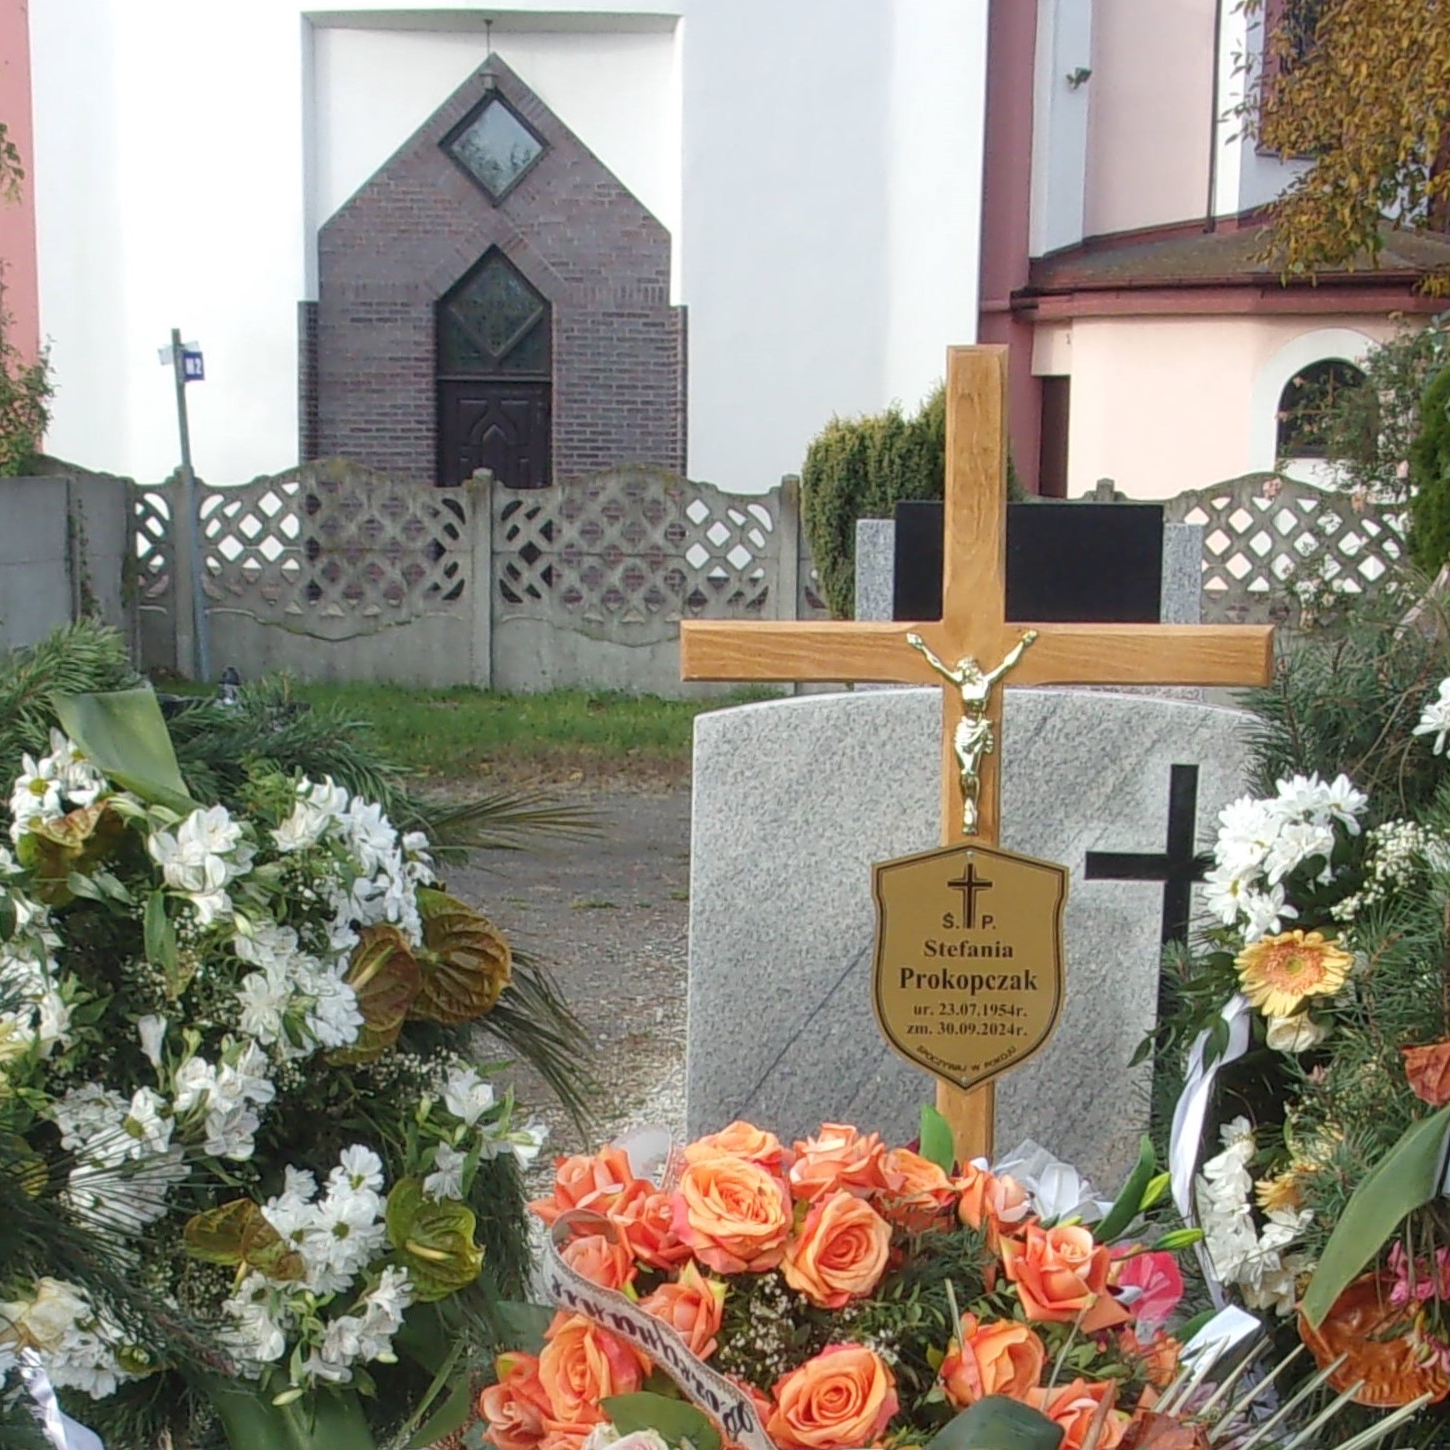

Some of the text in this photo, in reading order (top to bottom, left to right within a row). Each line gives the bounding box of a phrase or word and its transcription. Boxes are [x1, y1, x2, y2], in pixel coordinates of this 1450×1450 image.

[942, 912, 996, 930] Ś. P.
[923, 938, 1014, 959] Stefania
[899, 967, 1038, 996] Prokopczak
[913, 1002, 1028, 1018] ur. 23.07.1954r.
[906, 1021, 1028, 1037] zm. 30.09.2024r.
